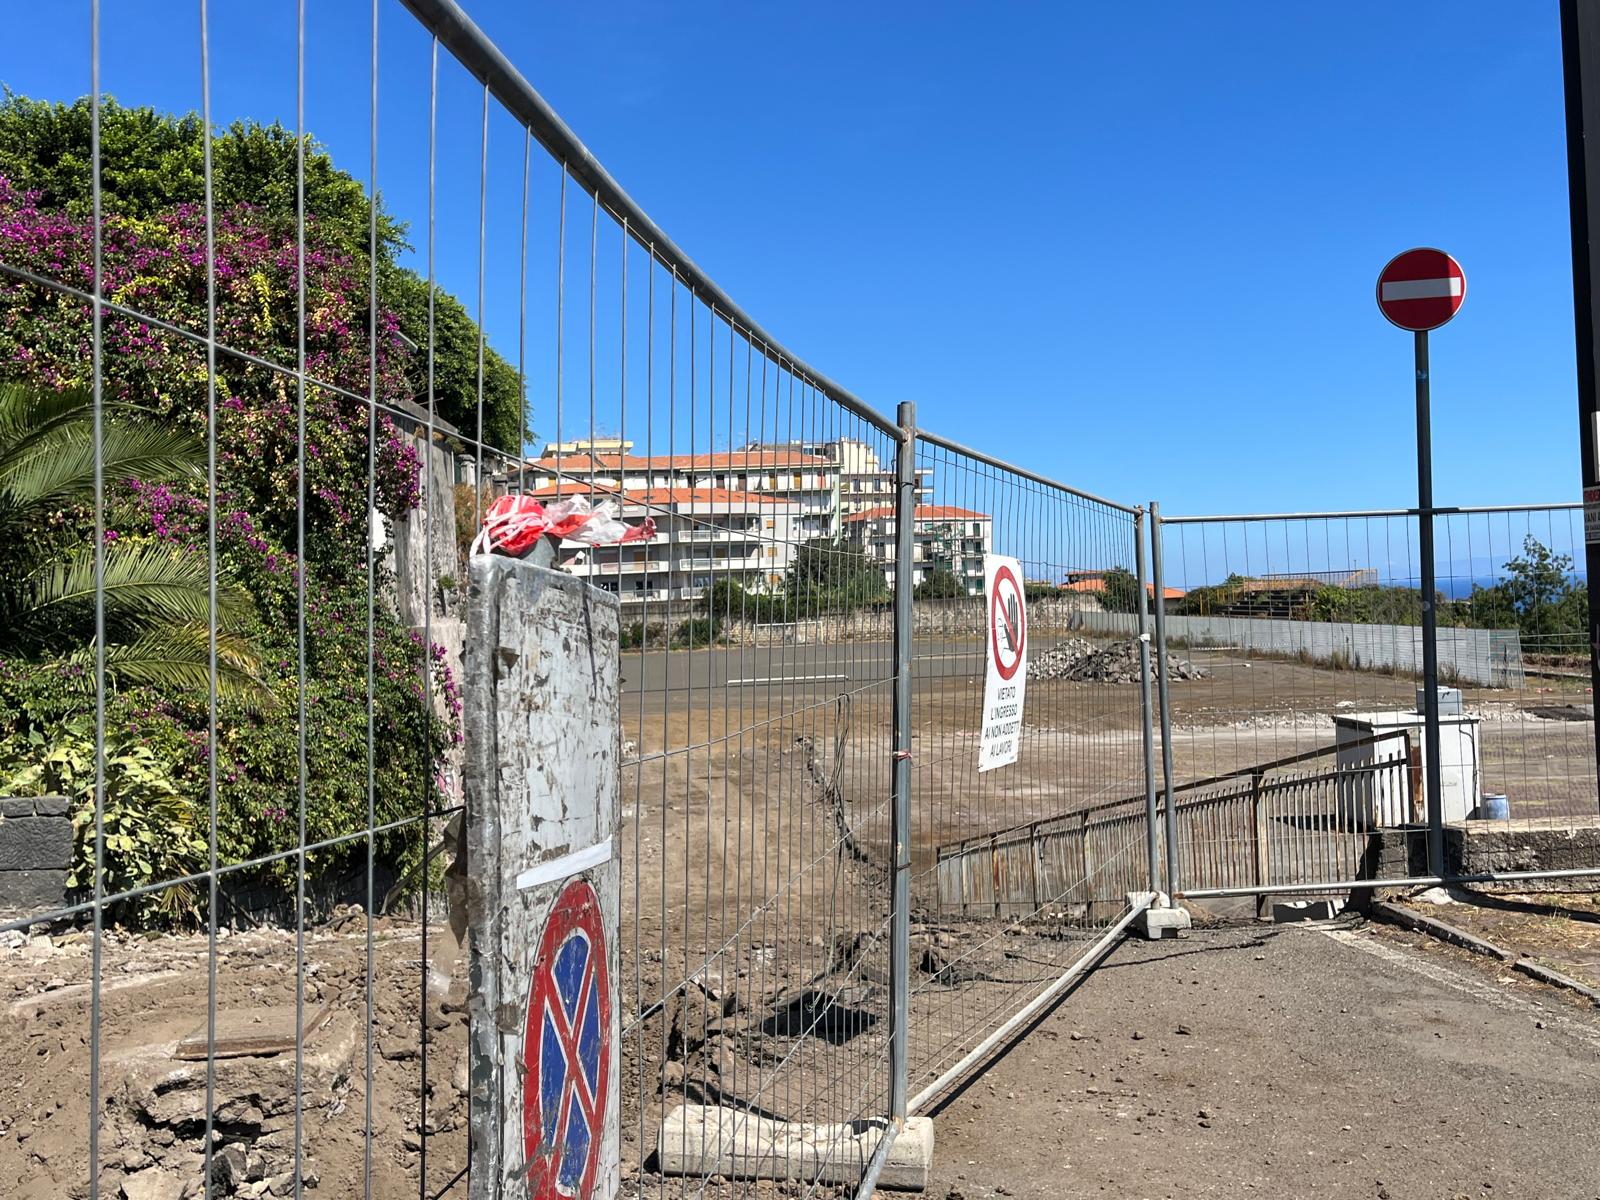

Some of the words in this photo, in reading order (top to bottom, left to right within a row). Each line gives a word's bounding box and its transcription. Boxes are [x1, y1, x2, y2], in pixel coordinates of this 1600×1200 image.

[997, 686, 1016, 700] VIETATO
[991, 704, 1018, 720] L'INGRESSO
[985, 727, 991, 740] AI
[991, 724, 1002, 739] NON
[1002, 720, 1020, 735] ADDETTI
[990, 744, 996, 757] AI
[996, 740, 1012, 756] LAVORI
